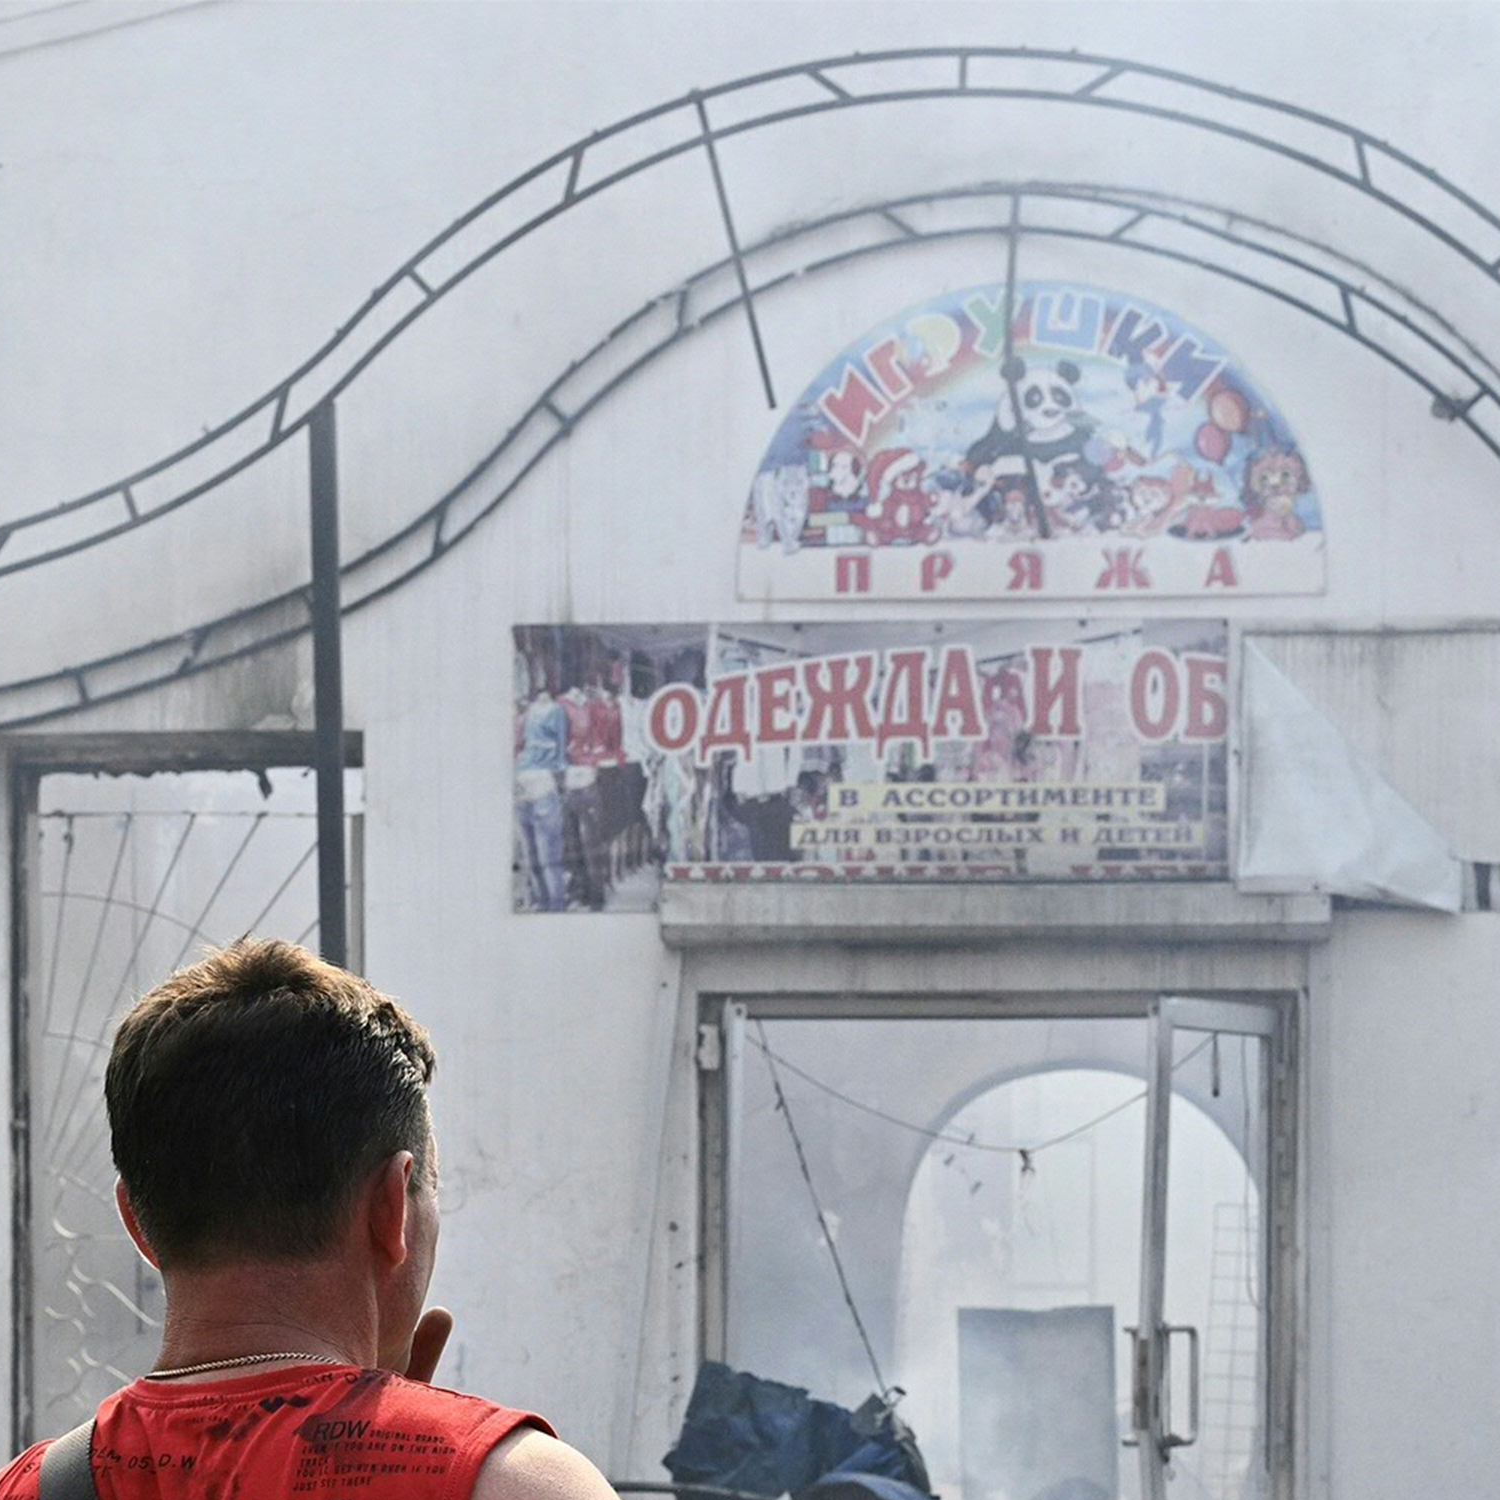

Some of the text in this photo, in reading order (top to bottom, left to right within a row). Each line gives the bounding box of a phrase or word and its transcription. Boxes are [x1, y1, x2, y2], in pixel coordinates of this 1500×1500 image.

[820, 290, 1228, 446] ИГРУШКИ
[835, 547, 1239, 593] ПРЯЖА
[650, 646, 1228, 763] ОДЕЖДА И ОБ
[838, 787, 1158, 808] В АССОРТИМЕНТЕ
[800, 824, 1193, 845] ДЛЯ ВЗРОСЛЫХ И ДЕТЕЙ
[314, 1419, 371, 1441] RDW
